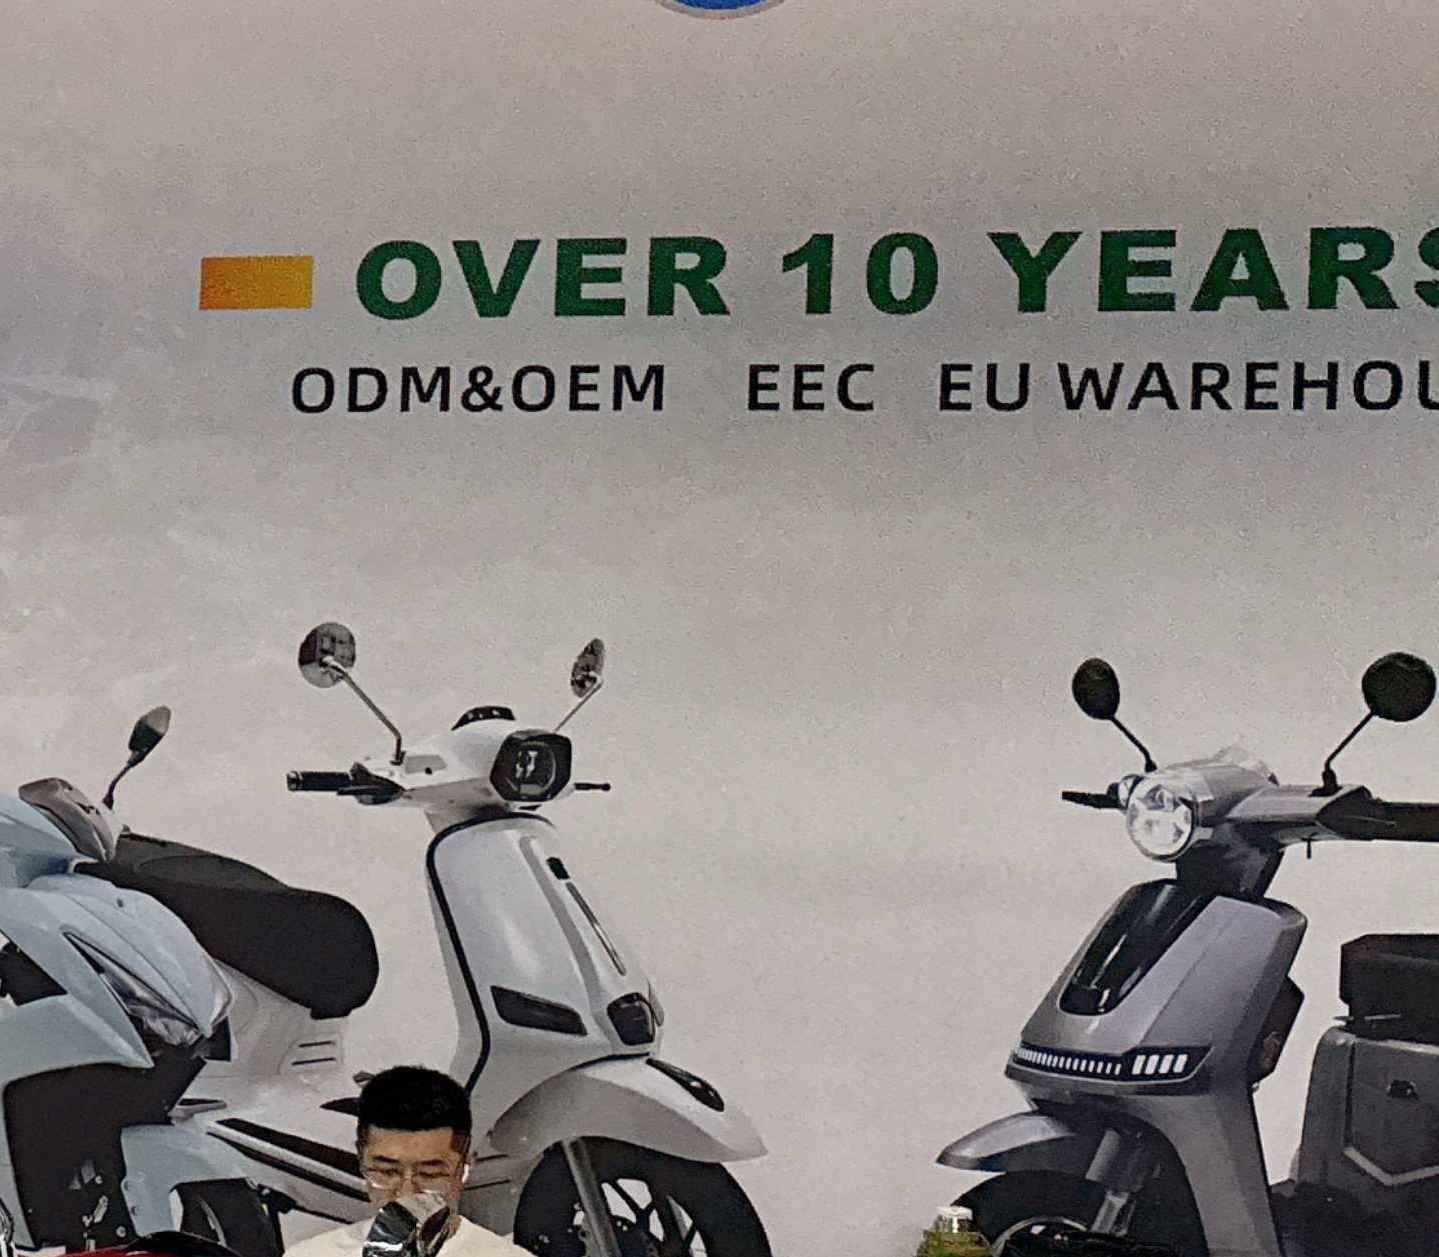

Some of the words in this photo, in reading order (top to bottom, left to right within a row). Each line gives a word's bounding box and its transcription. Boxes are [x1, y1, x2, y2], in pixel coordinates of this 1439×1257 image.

[356, 237, 731, 320] OVER
[781, 232, 939, 316] 10
[986, 226, 1439, 313] YEAR
[291, 364, 665, 414] ODM&OEM
[748, 363, 875, 412] EEC
[939, 362, 1031, 412] EU
